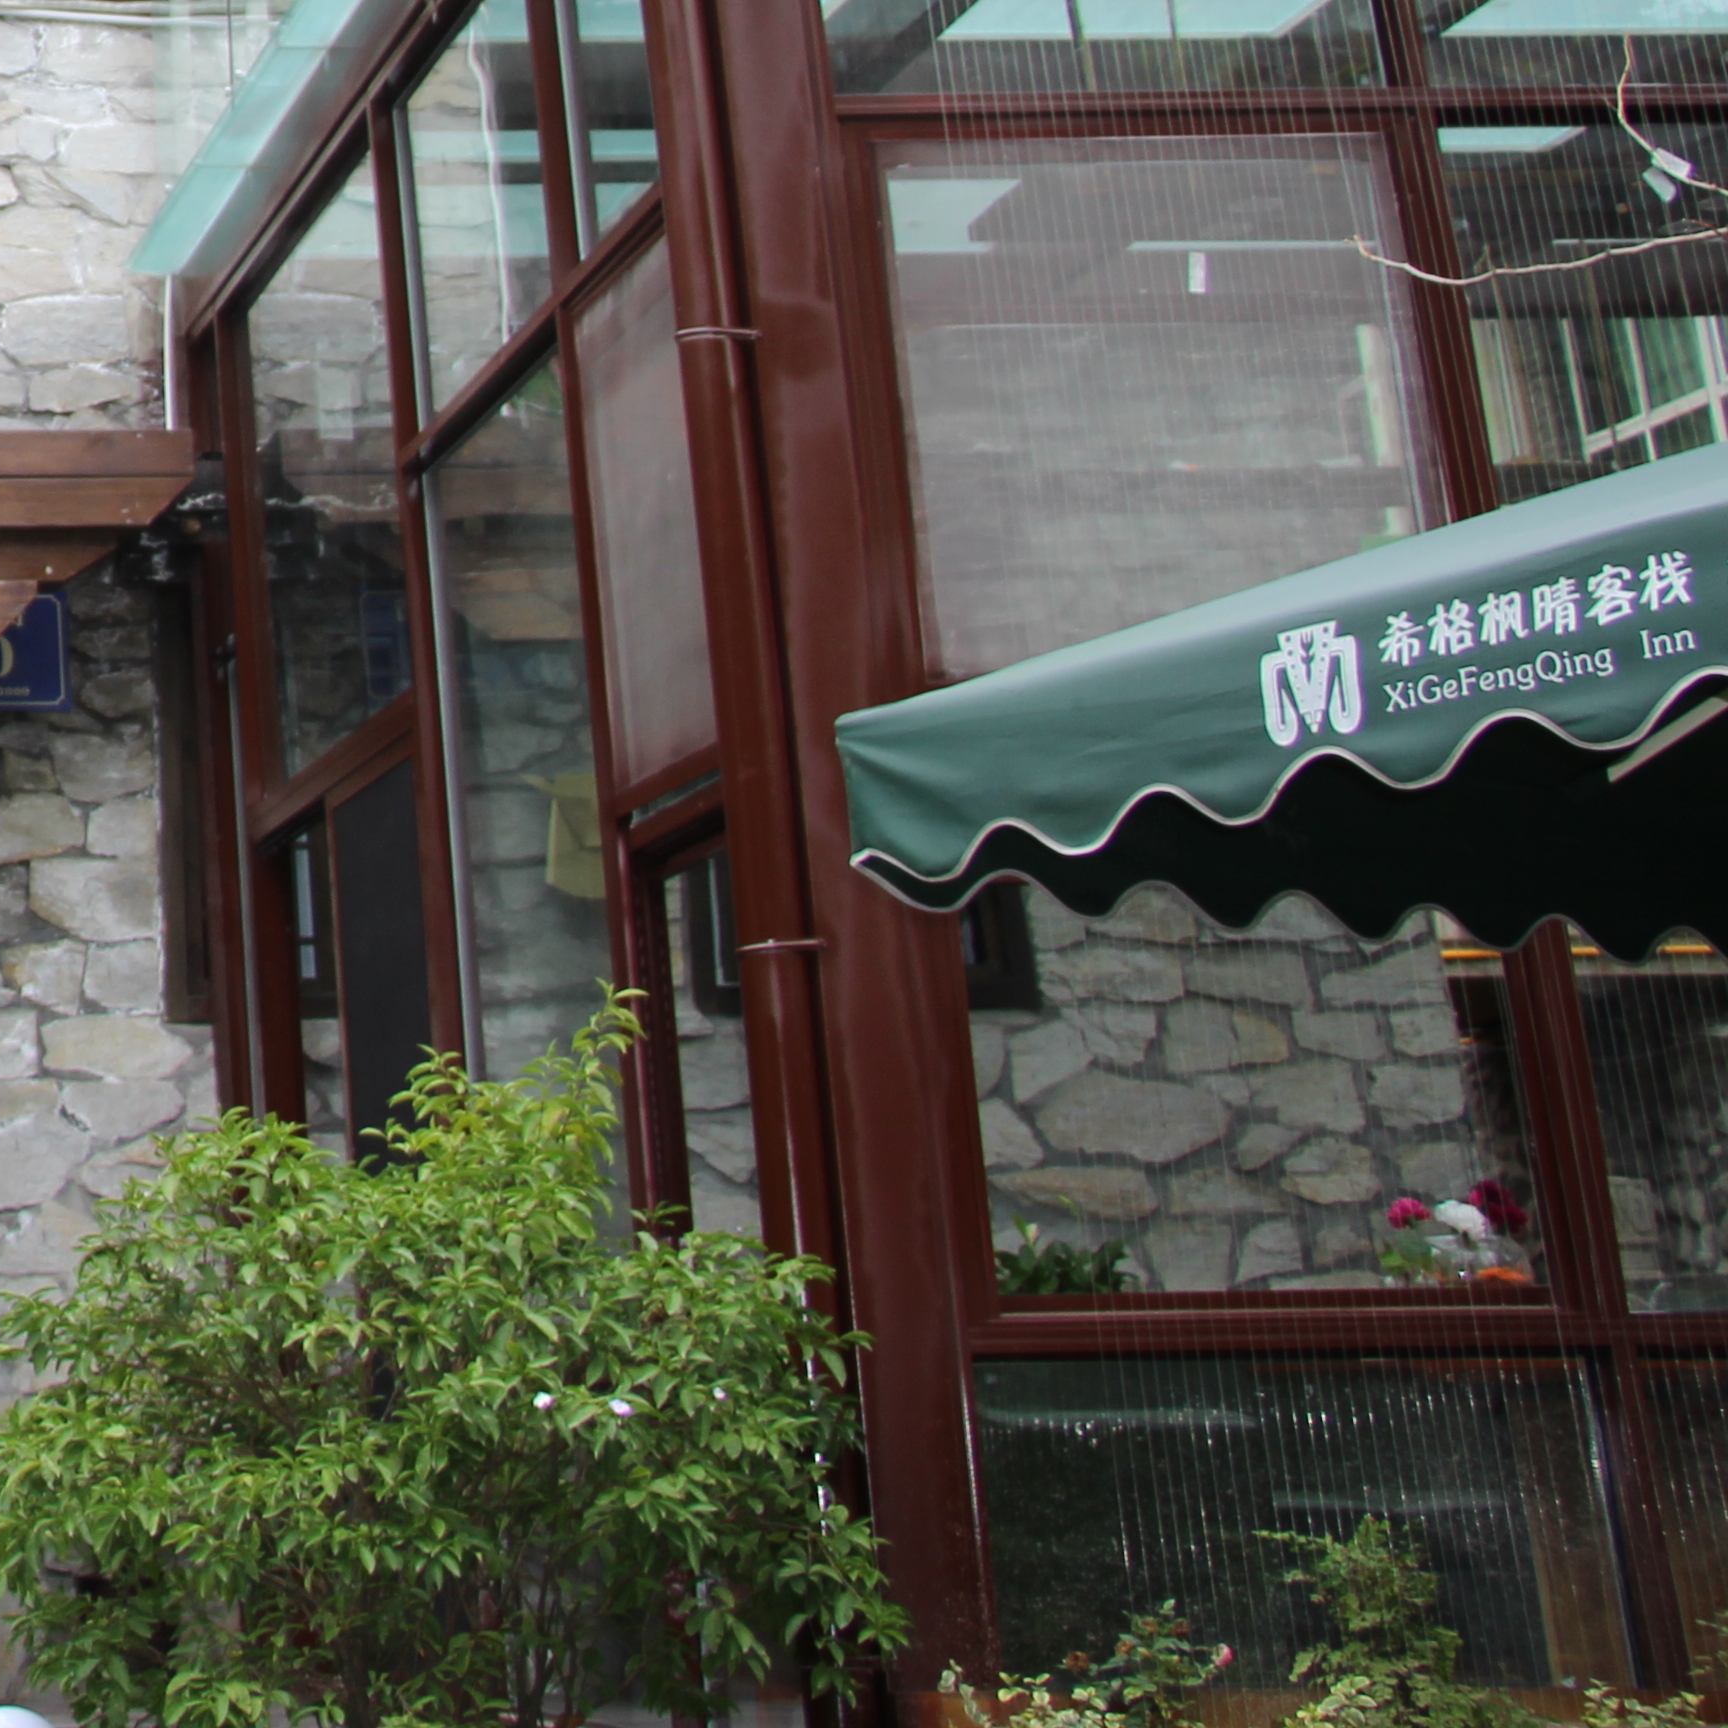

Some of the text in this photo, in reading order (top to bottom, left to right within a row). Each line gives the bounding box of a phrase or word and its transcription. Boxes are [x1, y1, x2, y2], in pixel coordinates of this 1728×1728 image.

[1378, 551, 1694, 665] 希格枫晴客栈
[1382, 628, 1696, 713] XiGeFengQing Inn
